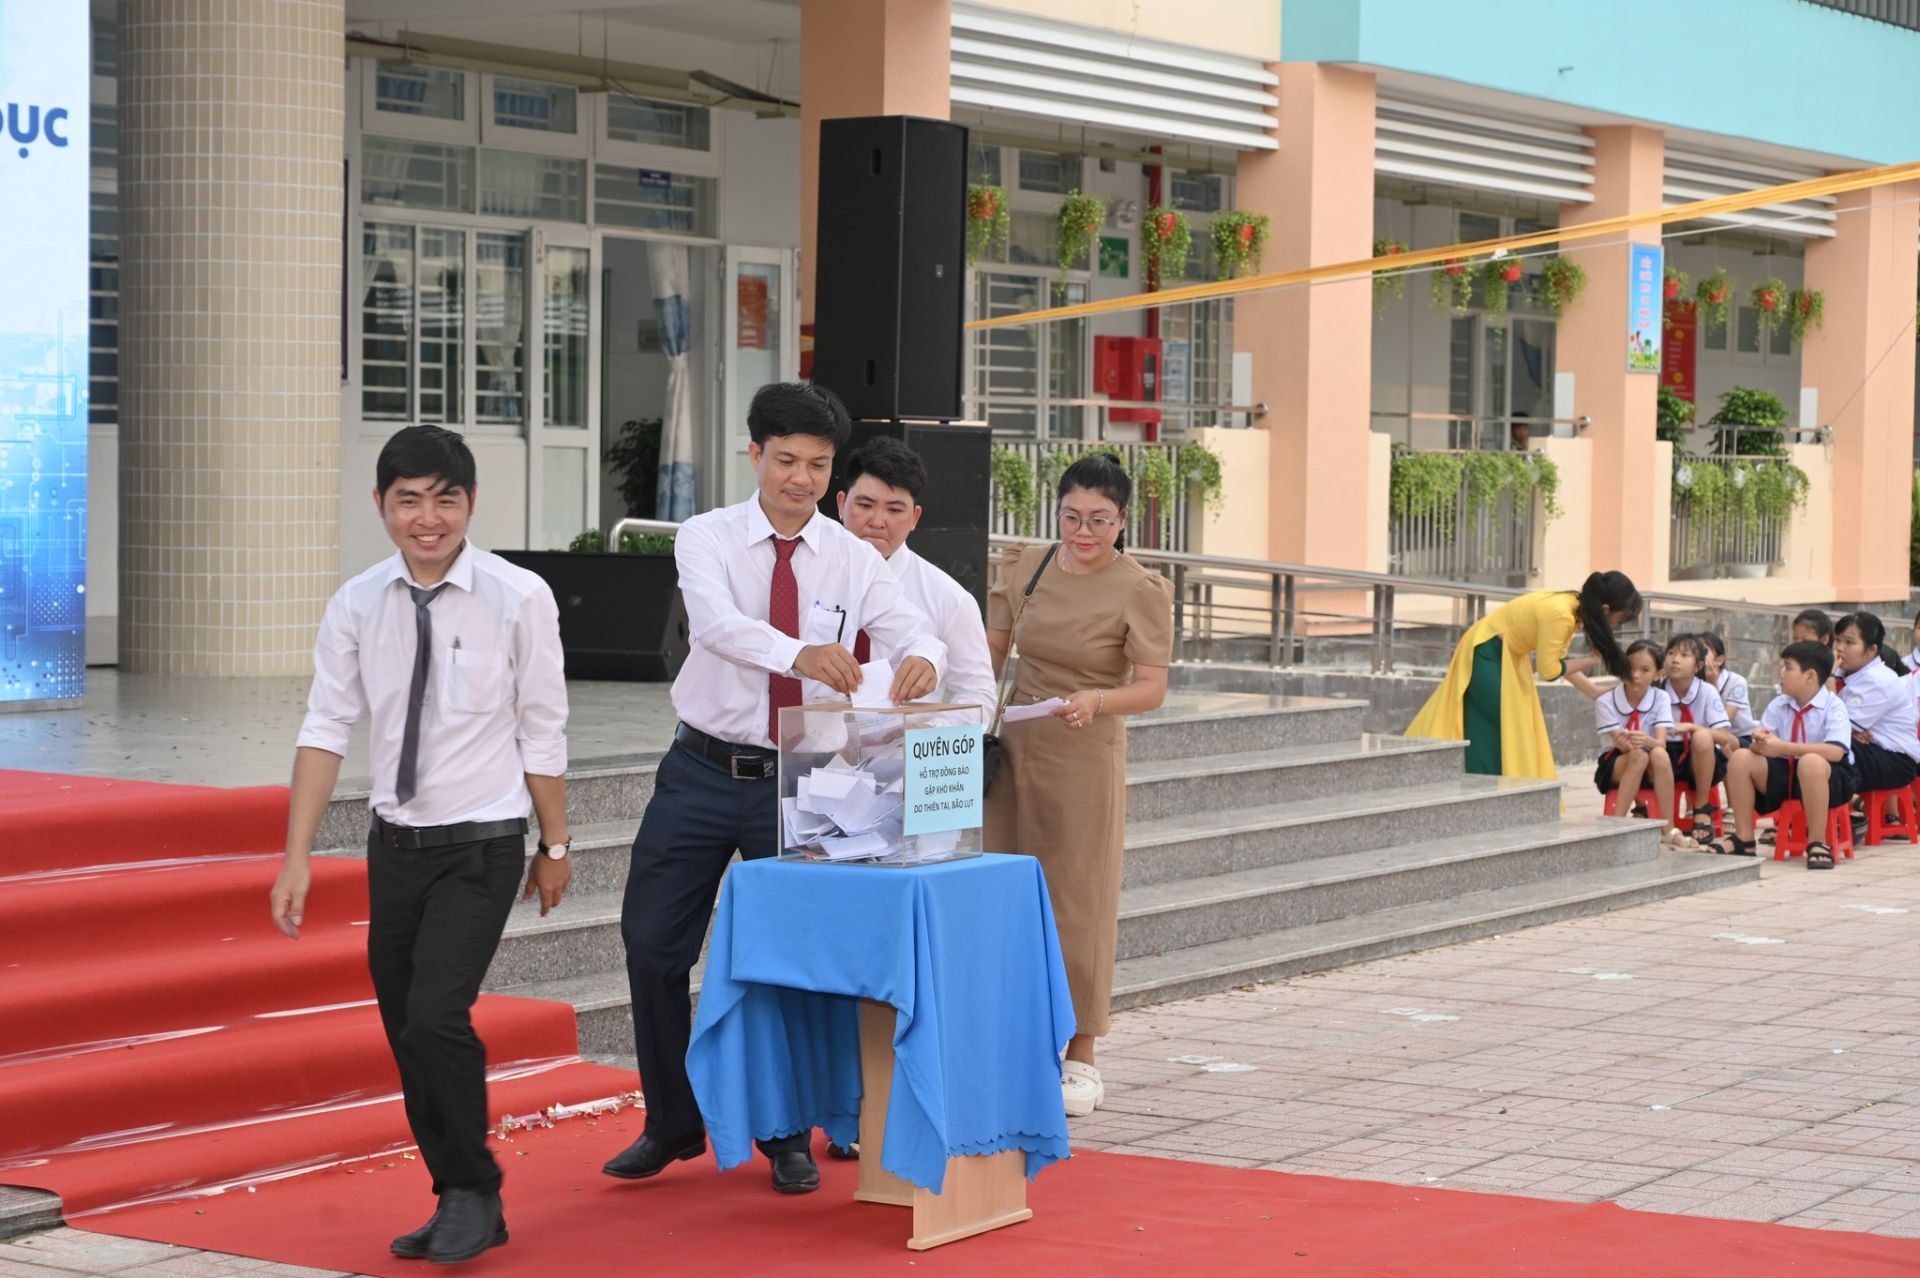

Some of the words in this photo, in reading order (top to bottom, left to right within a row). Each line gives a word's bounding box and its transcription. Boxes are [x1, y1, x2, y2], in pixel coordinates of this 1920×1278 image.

[0, 103, 68, 158] ỤC
[913, 736, 950, 760] QUYÊN
[952, 734, 975, 755] GÓP
[914, 804, 923, 813] DO
[924, 801, 939, 812] THIÊN
